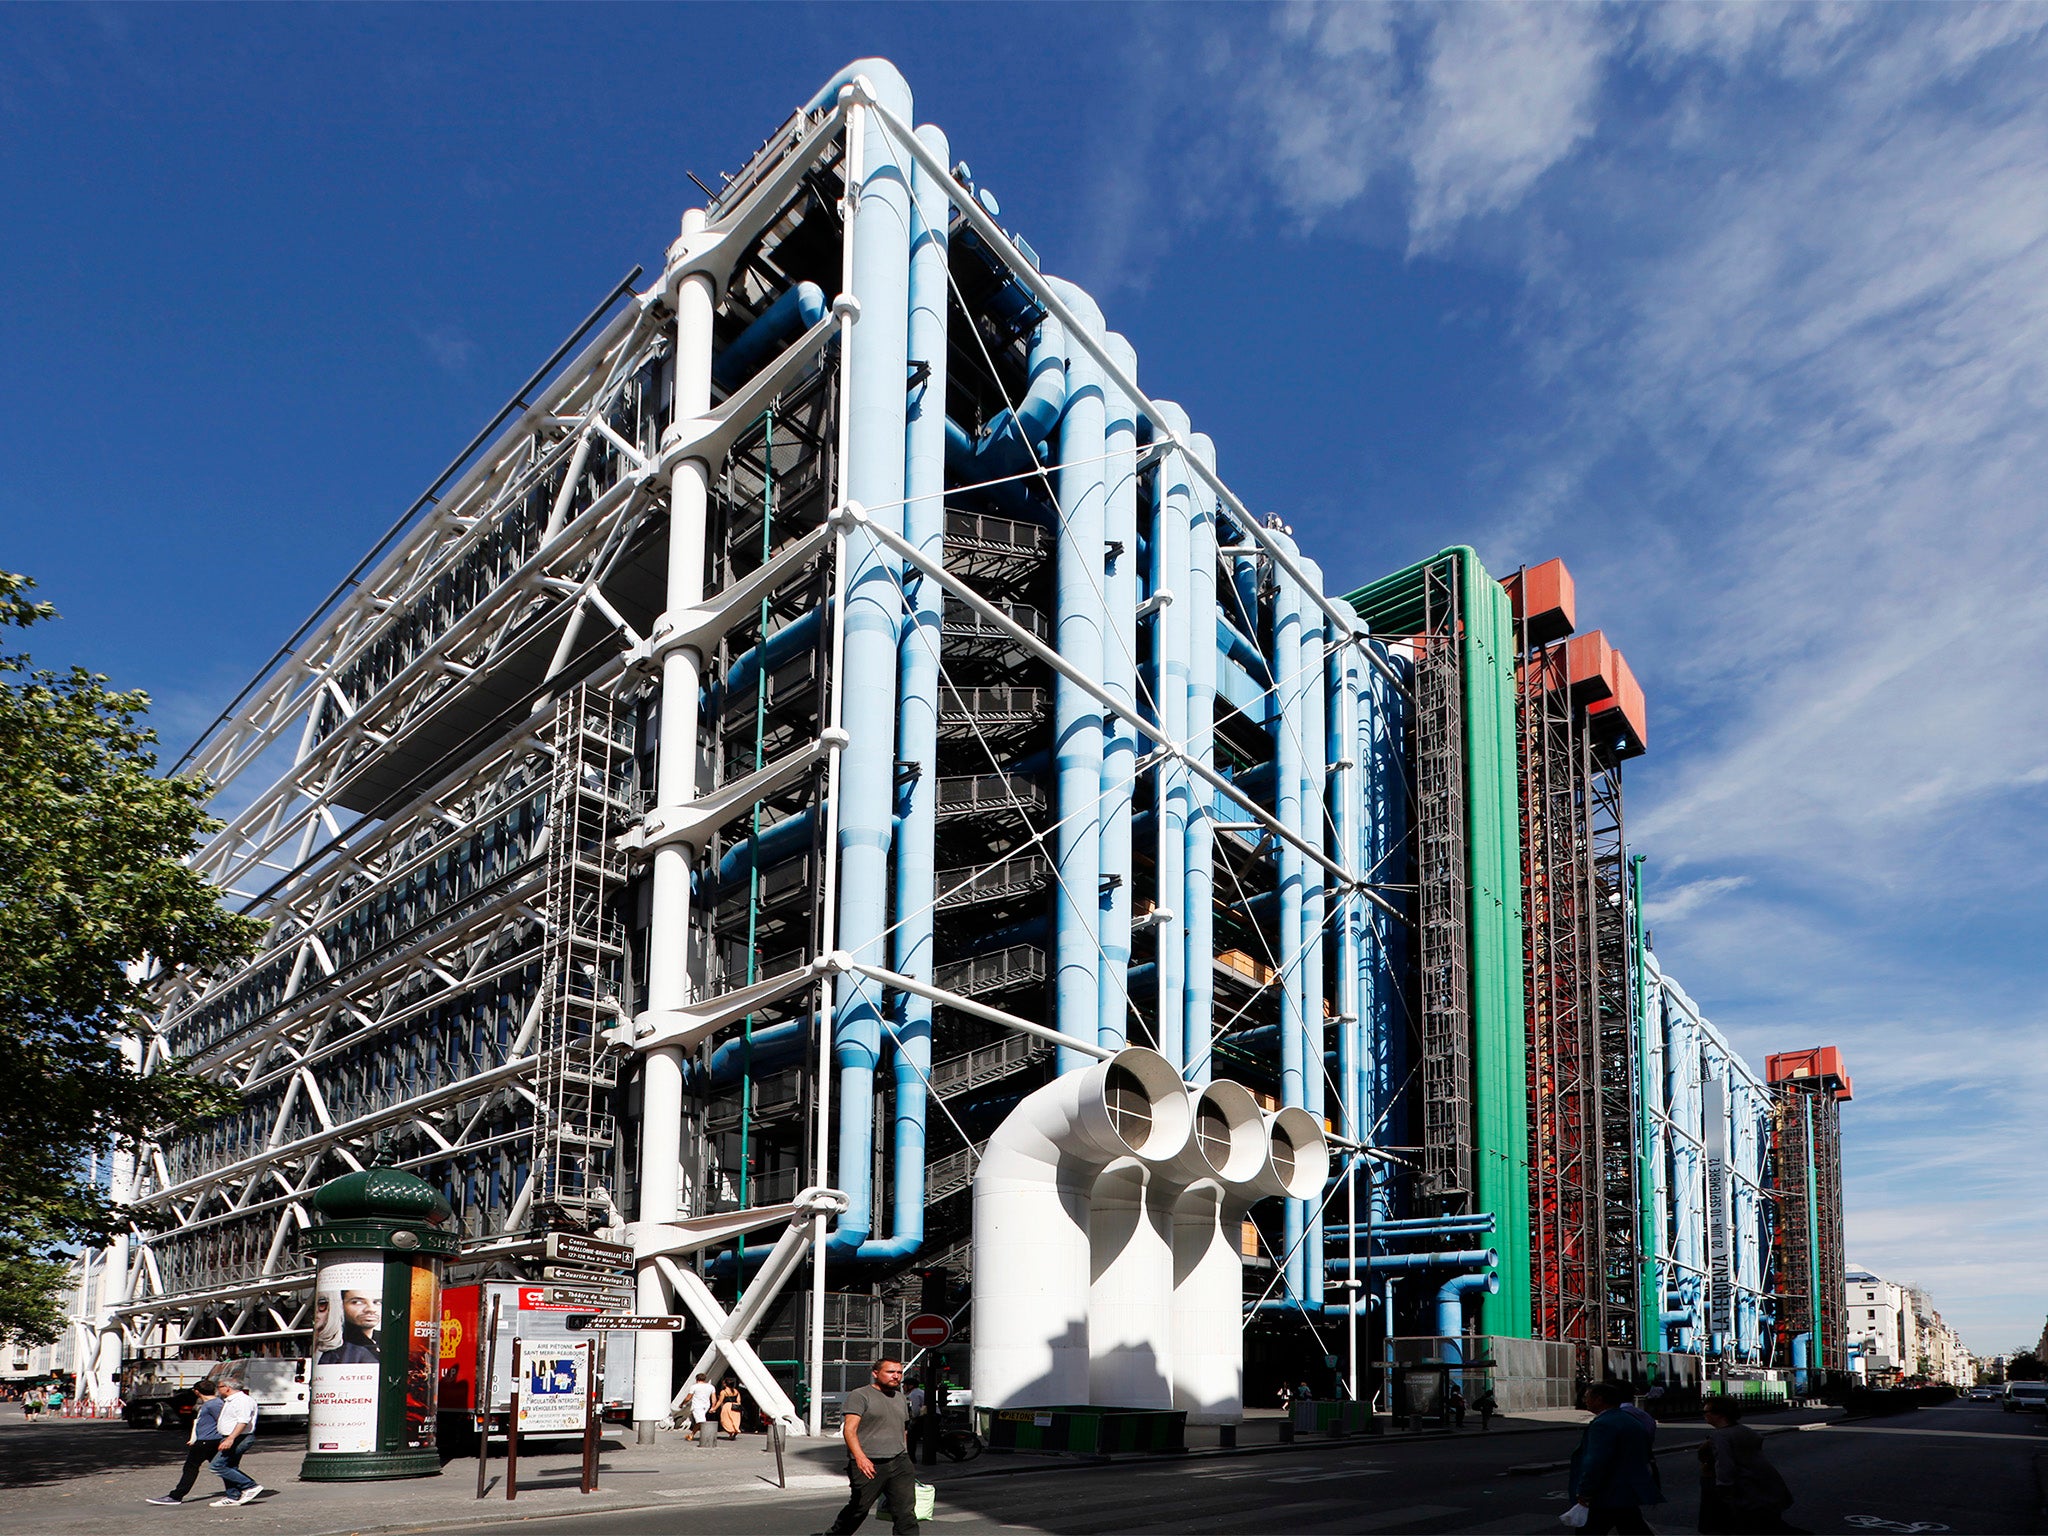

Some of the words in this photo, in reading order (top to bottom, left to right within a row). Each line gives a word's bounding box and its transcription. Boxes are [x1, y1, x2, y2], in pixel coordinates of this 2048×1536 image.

[1709, 1168, 1721, 1208] SEPTEMBRE
[1710, 1222, 1723, 1237] JUIN
[565, 1272, 590, 1281] Quartier
[1711, 1253, 1729, 1313] TENDENZA
[1712, 1318, 1729, 1331] LA
